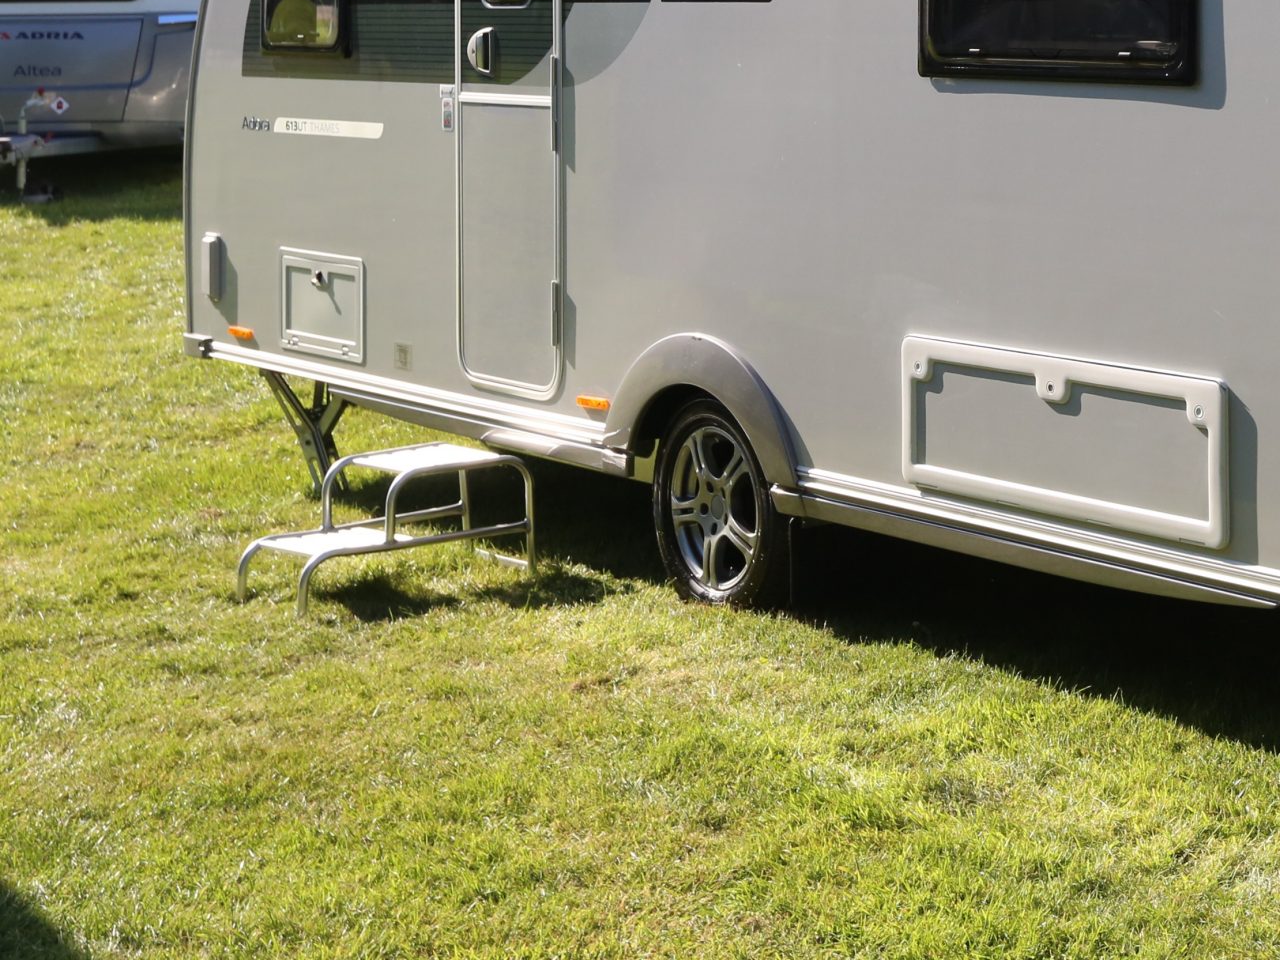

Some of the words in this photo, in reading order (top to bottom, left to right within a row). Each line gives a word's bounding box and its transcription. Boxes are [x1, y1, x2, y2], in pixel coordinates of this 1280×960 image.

[15, 31, 84, 40] ADRIA
[14, 65, 62, 77] Altea
[241, 116, 270, 131] Adora
